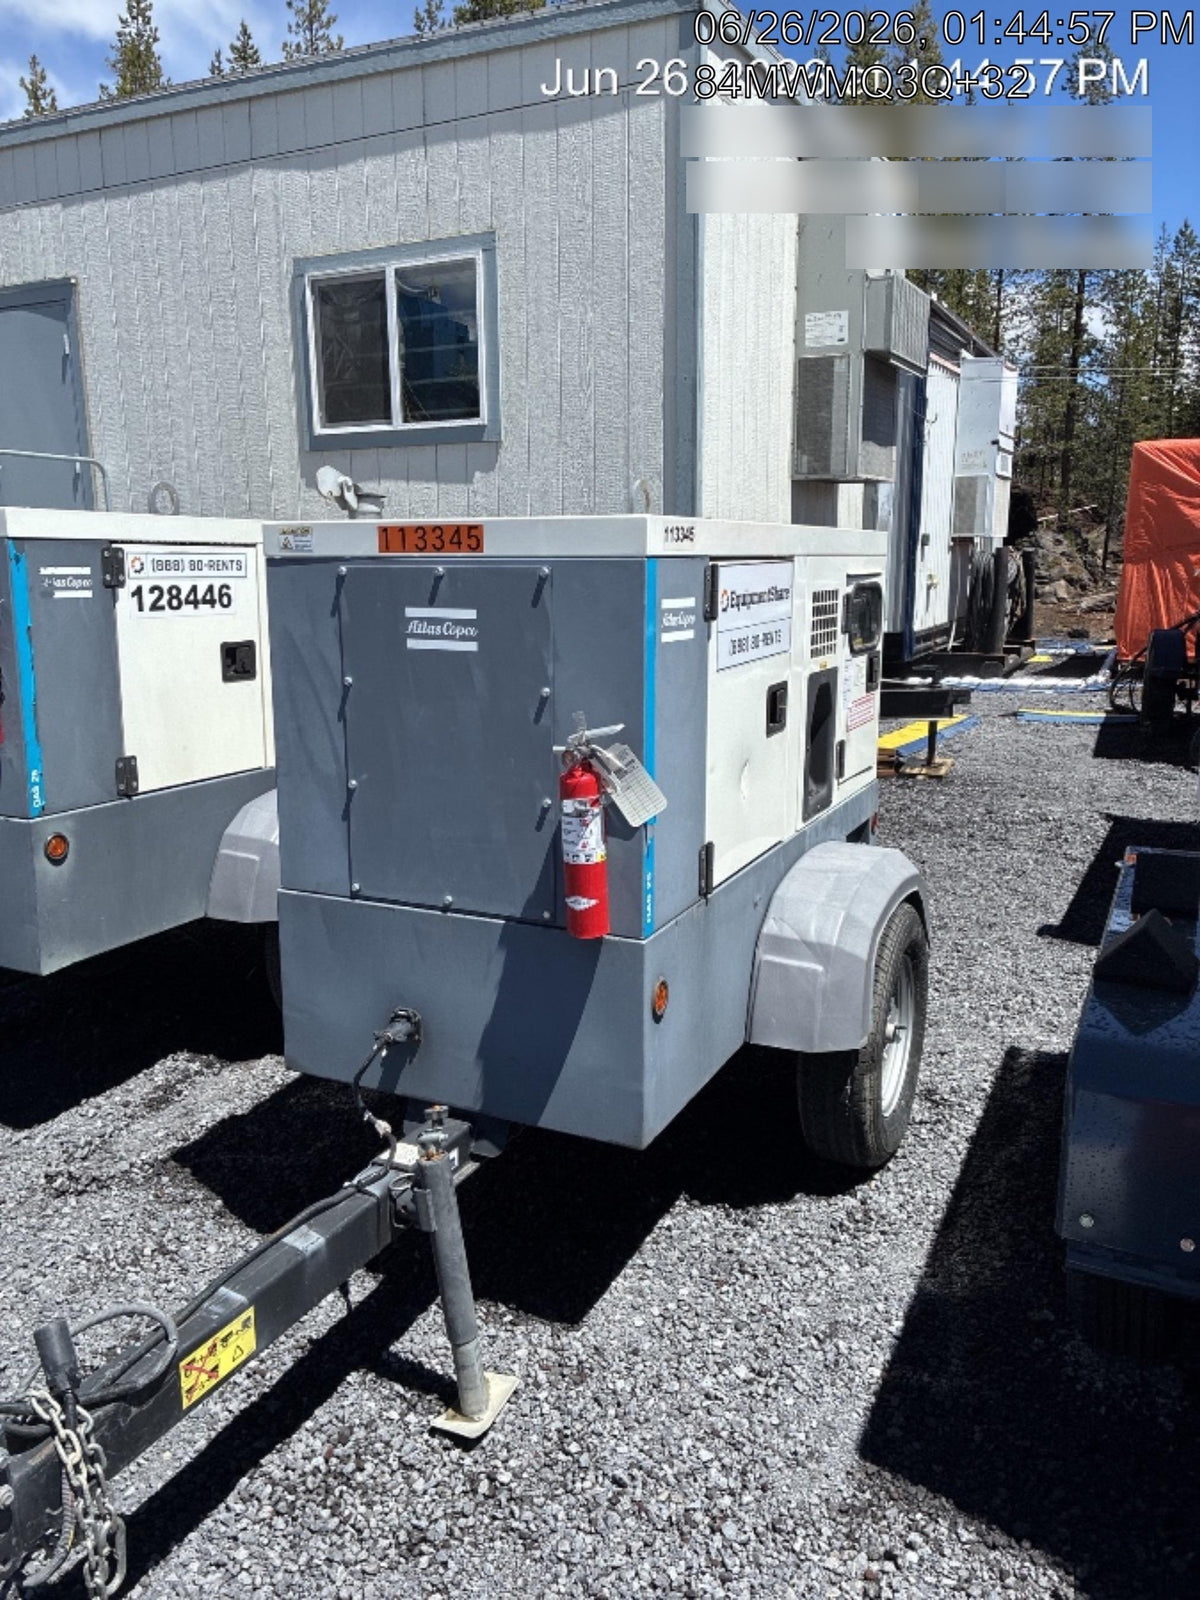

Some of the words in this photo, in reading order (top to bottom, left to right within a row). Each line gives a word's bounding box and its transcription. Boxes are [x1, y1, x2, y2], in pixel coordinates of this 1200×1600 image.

[380, 525, 481, 551] 113345
[664, 525, 694, 543] 113345
[131, 583, 232, 612] 128446
[405, 620, 441, 636] Atlas
